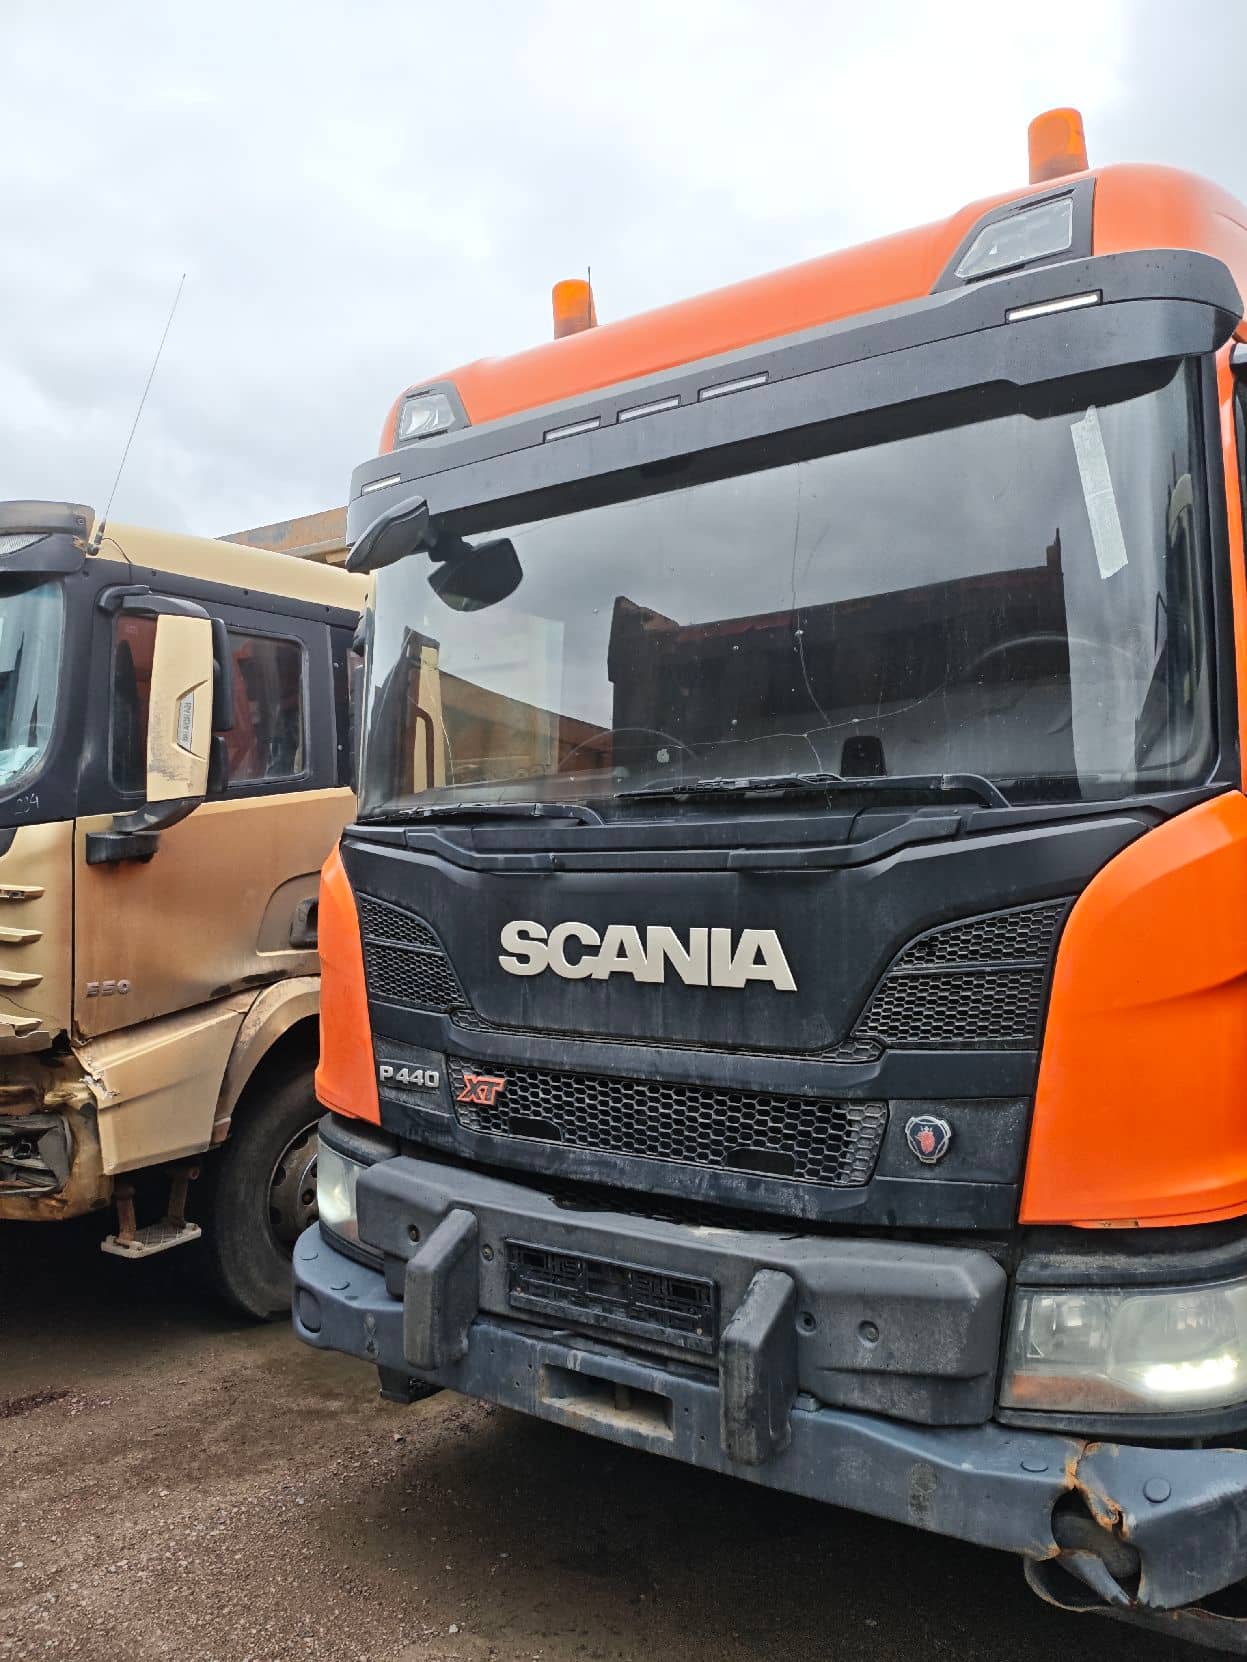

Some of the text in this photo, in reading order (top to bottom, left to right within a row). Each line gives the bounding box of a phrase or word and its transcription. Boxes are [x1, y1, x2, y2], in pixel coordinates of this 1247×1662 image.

[498, 920, 798, 991] SCANIA
[86, 979, 130, 997] 550
[456, 1073, 506, 1105] XT
